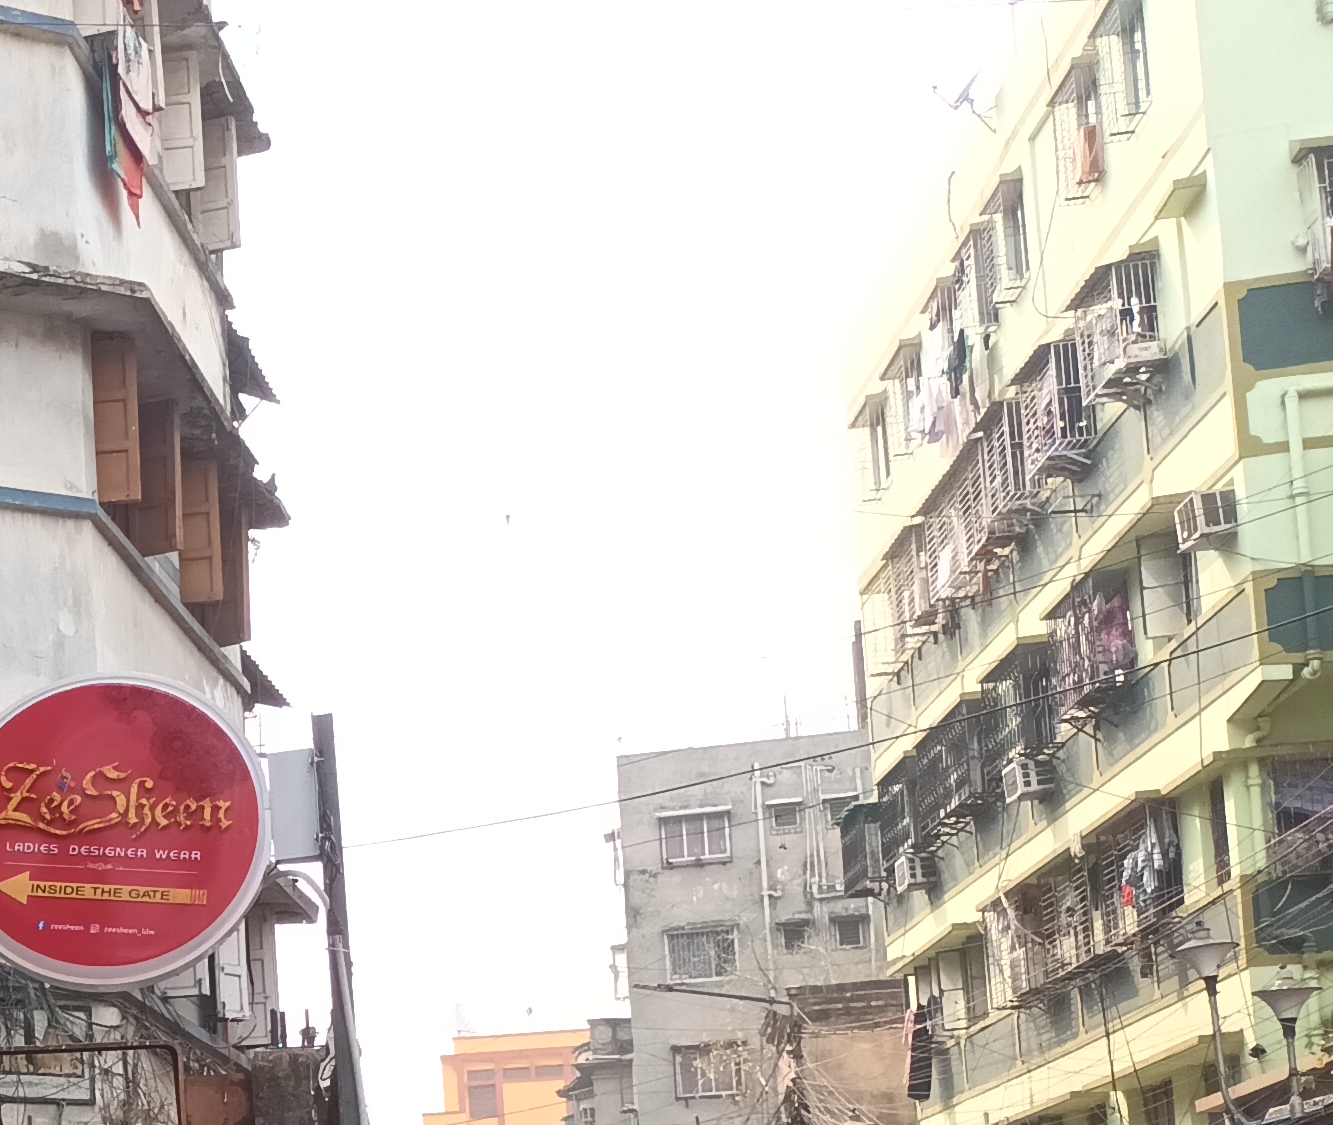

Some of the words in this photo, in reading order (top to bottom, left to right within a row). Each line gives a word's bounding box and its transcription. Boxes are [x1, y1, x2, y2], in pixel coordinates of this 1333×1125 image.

[75, 761, 234, 839] Sheen
[6, 841, 59, 855] LADIES
[69, 844, 147, 859] DESIGNER
[154, 848, 201, 862] WEAR
[31, 883, 86, 897] INSIDE
[92, 886, 123, 899] THE
[129, 889, 171, 902] GATE
